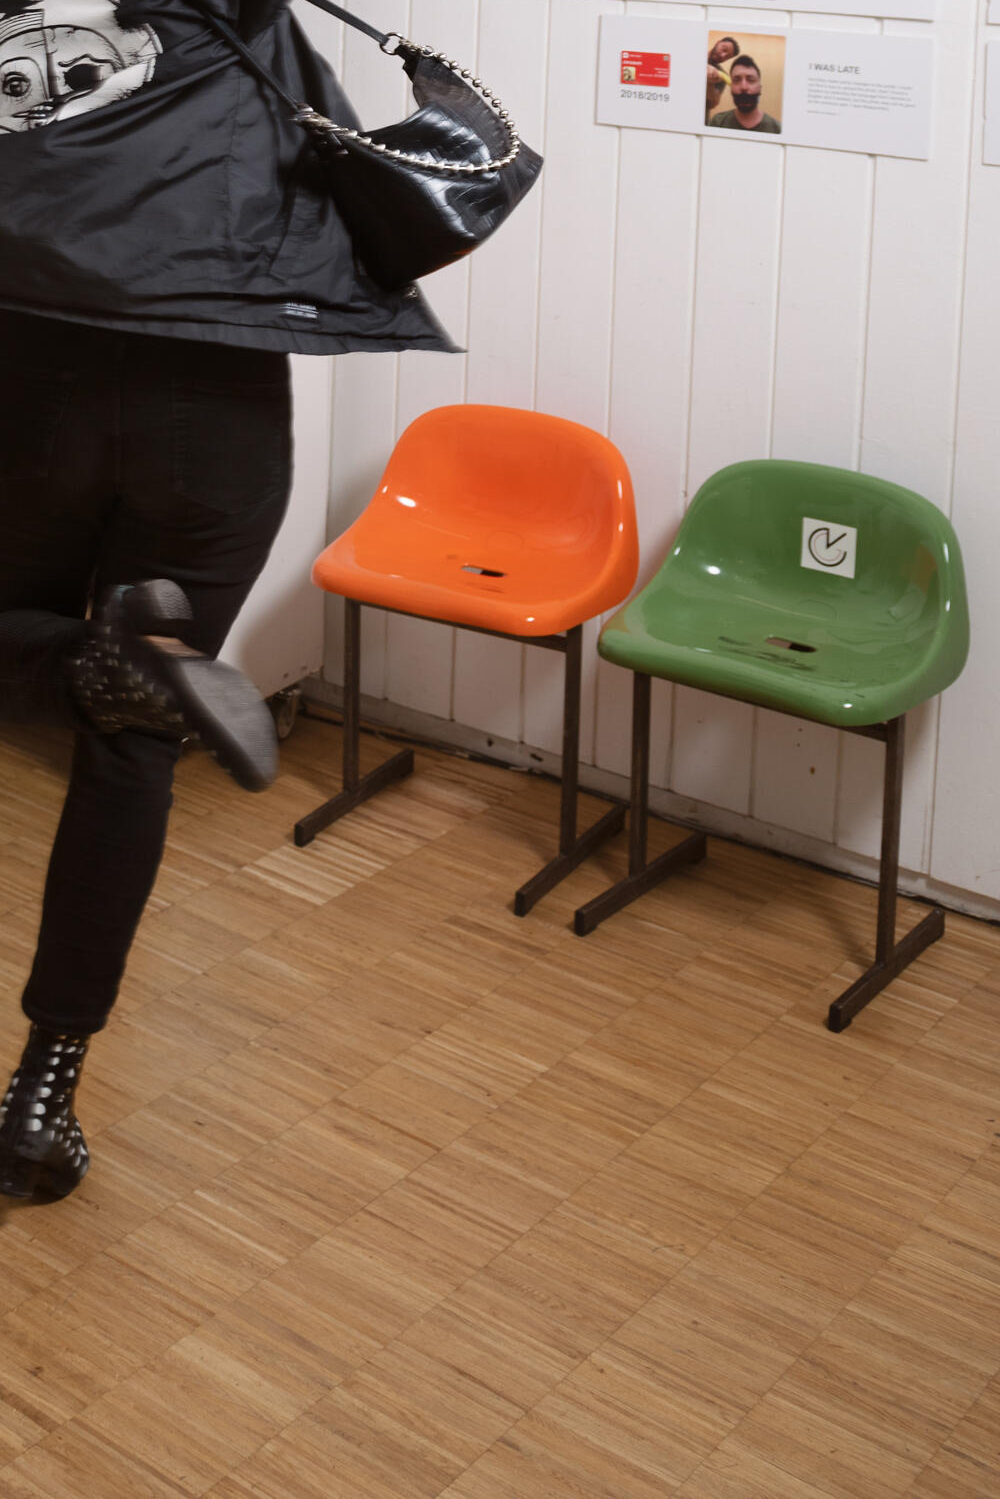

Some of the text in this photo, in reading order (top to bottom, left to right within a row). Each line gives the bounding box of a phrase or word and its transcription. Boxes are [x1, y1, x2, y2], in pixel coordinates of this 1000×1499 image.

[814, 63, 834, 72] WAS
[837, 65, 860, 74] LATE
[620, 90, 670, 102] 2018/2019
